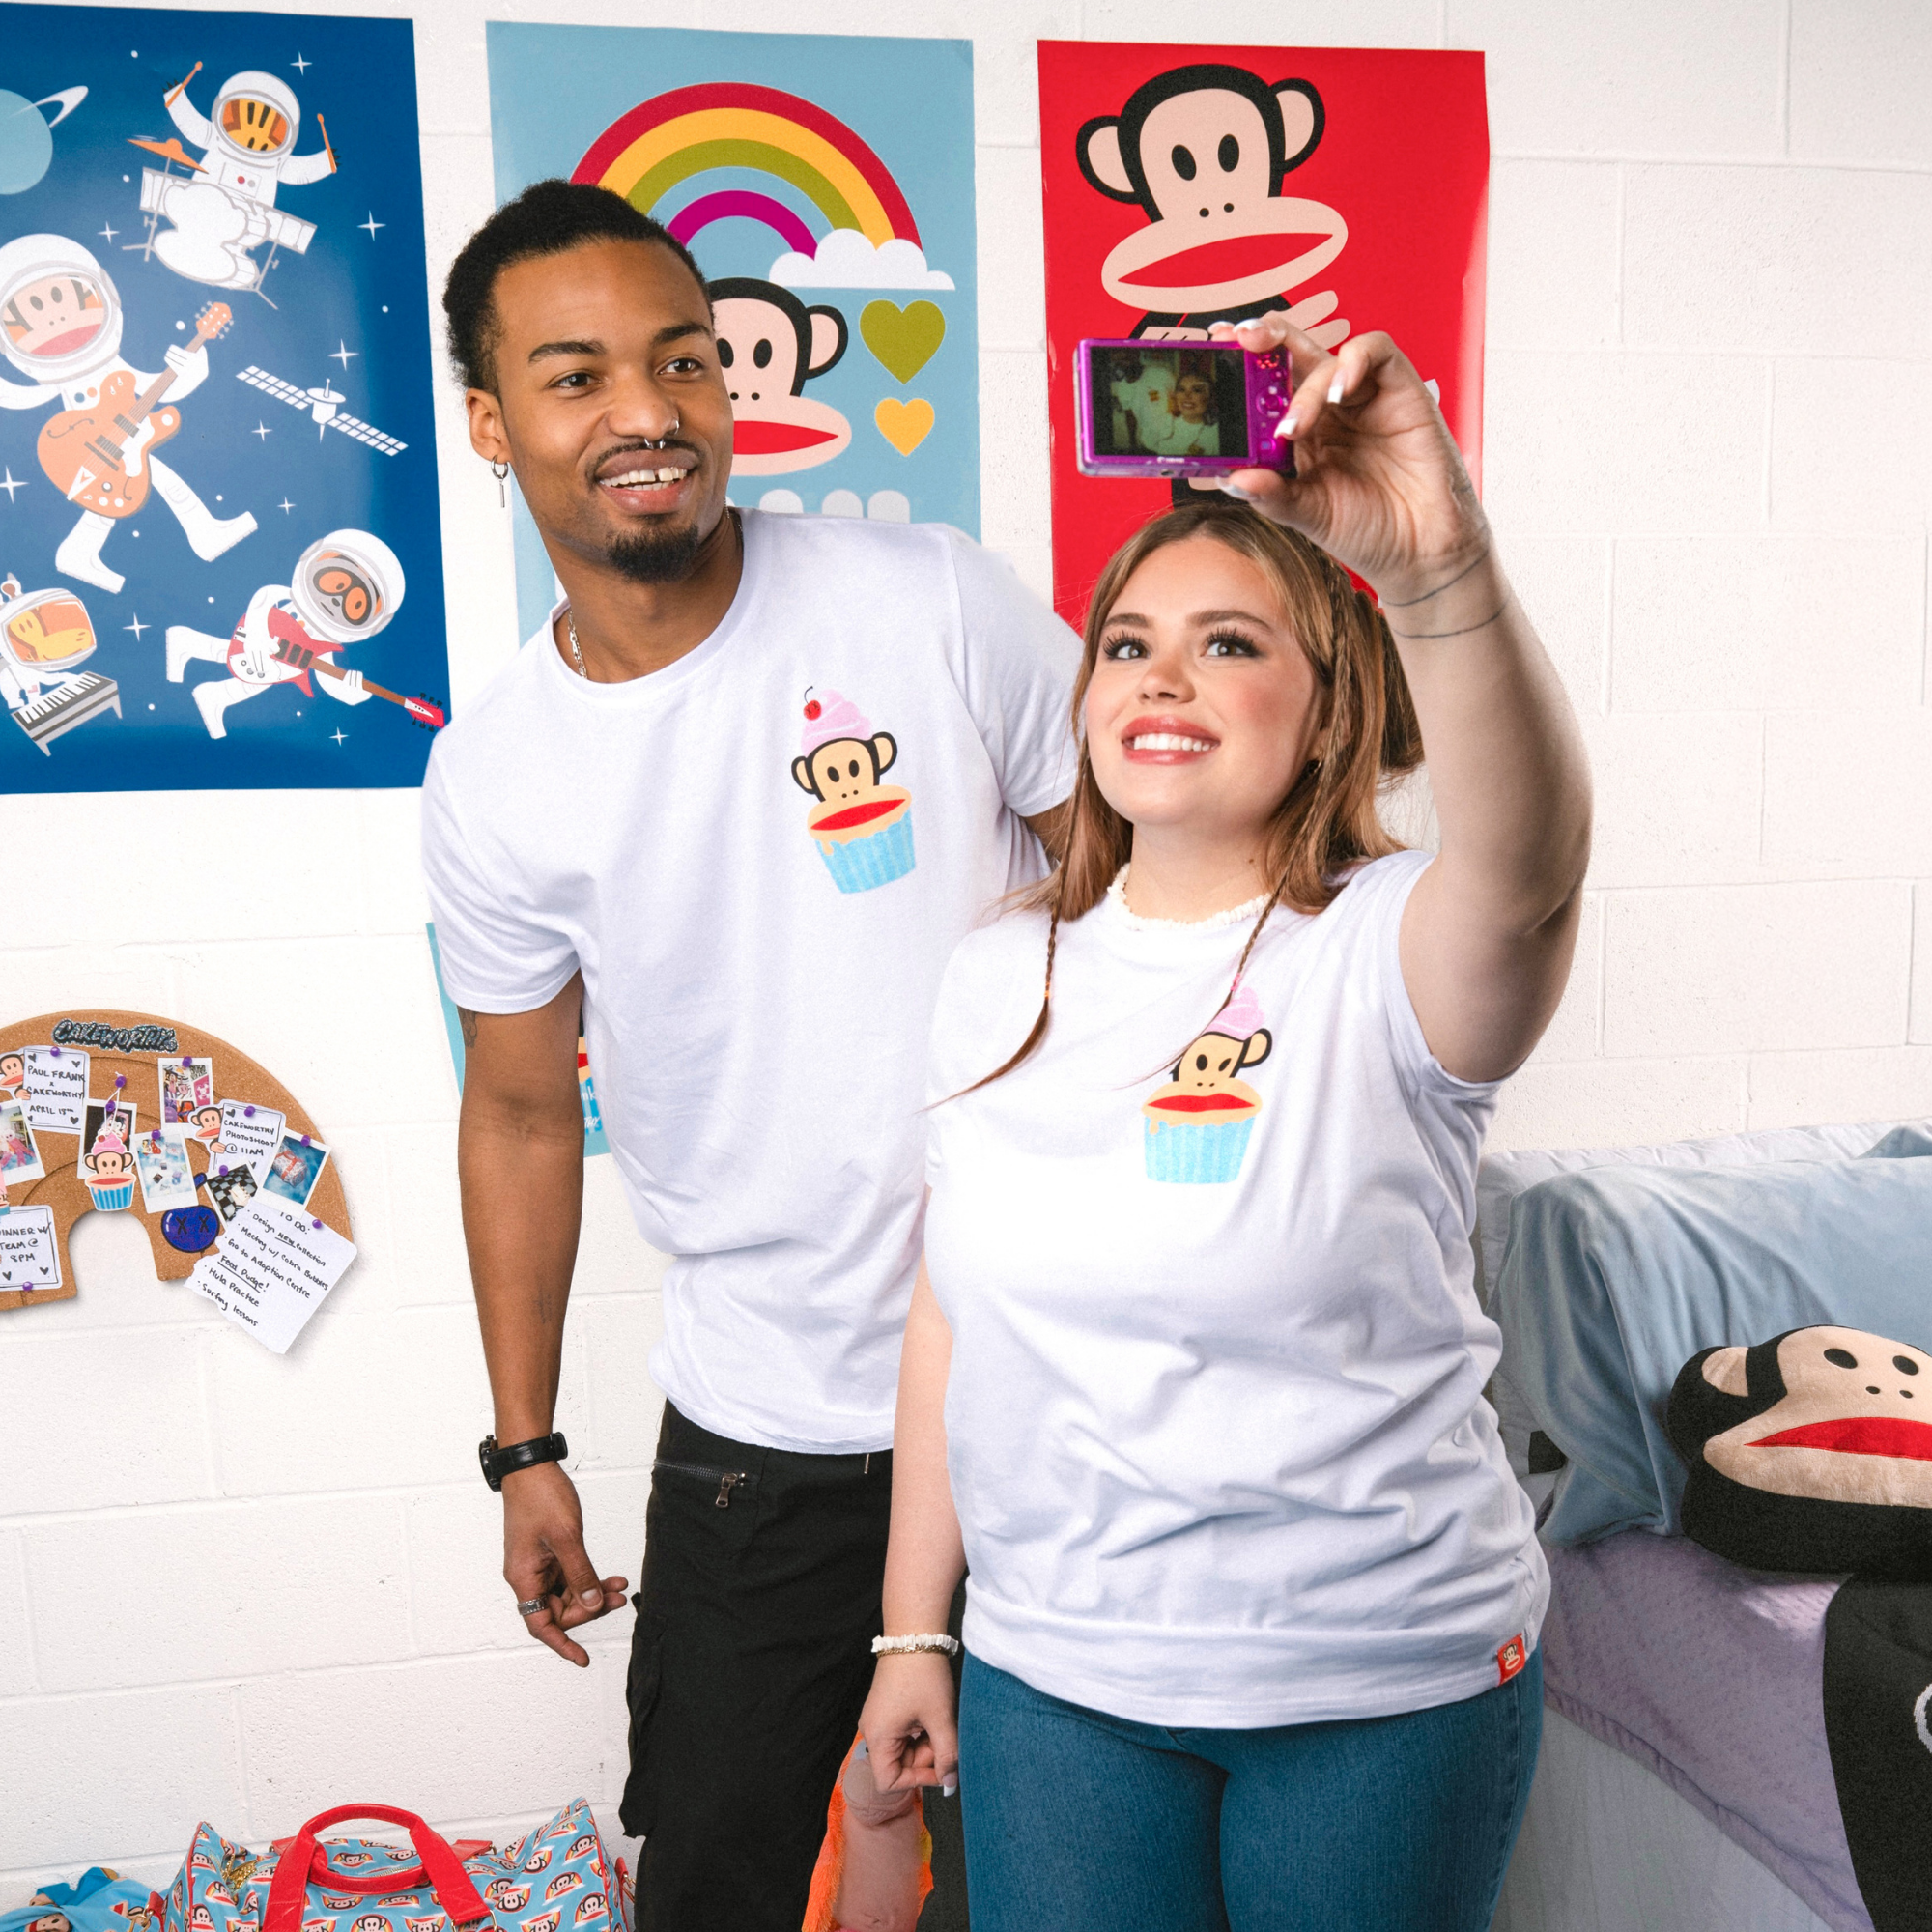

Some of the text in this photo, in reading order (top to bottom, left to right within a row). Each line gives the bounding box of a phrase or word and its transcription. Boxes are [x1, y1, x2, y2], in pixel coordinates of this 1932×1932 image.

[28, 1065, 85, 1082] PAUL FRANK
[27, 1086, 85, 1099] CAKEWORTHY
[30, 1105, 55, 1115] APRIL
[223, 1119, 275, 1135] CAKEWORTHY
[225, 1129, 276, 1148] PHOTOSHOOT
[241, 1147, 264, 1157] 11AM
[0, 1227, 36, 1236] INNER
[252, 1213, 275, 1234] Design
[10, 1253, 36, 1263] 8PM
[220, 1255, 238, 1272] Feed
[250, 1256, 285, 1282] Adoption
[286, 1277, 311, 1299] Centre
[281, 1254, 301, 1272] Cobra
[303, 1269, 329, 1291] Bubbles
[208, 1267, 260, 1307] Hula Practice
[233, 1304, 259, 1327] lessons
